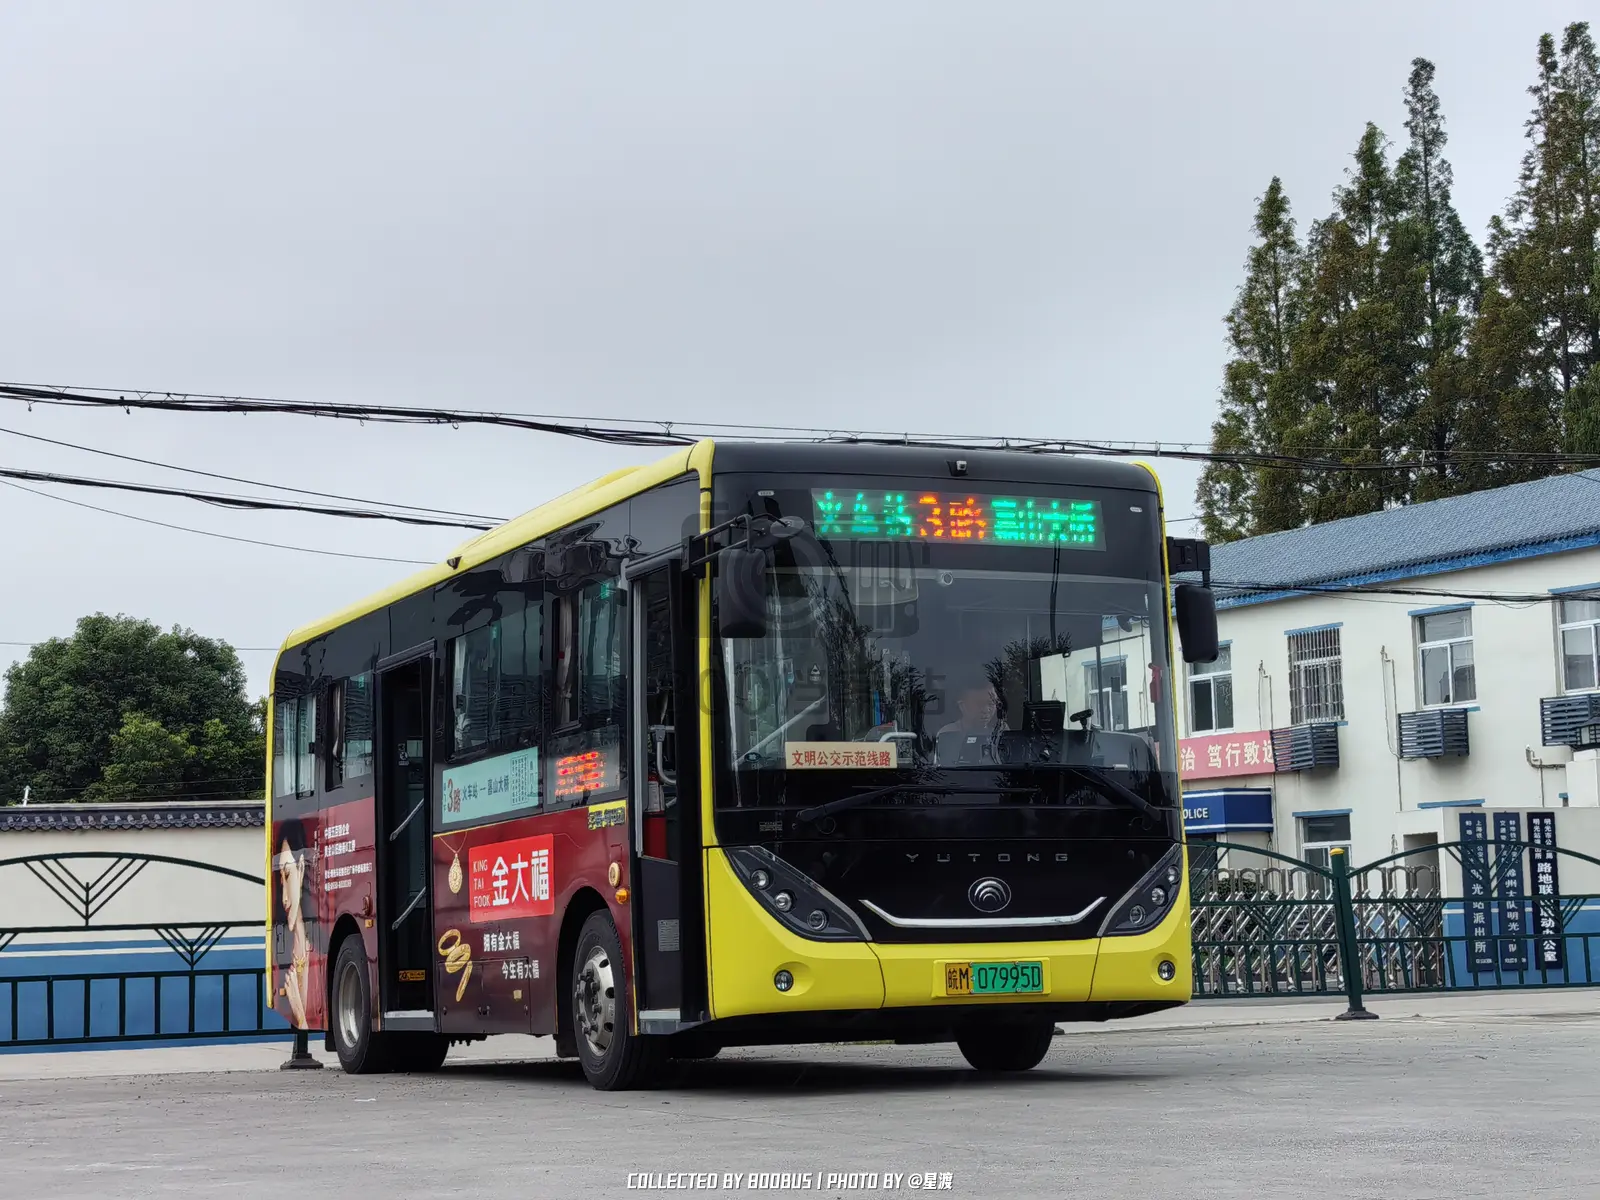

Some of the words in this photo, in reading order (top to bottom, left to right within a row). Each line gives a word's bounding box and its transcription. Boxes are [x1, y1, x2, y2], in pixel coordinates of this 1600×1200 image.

[791, 750, 891, 767] 文明公交示范线路
[1180, 746, 1196, 771] 治
[1183, 807, 1209, 819] OLICE
[1543, 818, 1554, 860] 明光市公局
[473, 859, 489, 874] KING
[905, 853, 1068, 863] YUTONG
[473, 877, 484, 892] TAI
[492, 849, 550, 907] 金大福
[473, 894, 491, 909] FOOK
[501, 959, 540, 980] 今生有大福
[977, 966, 1041, 990] 07995D
